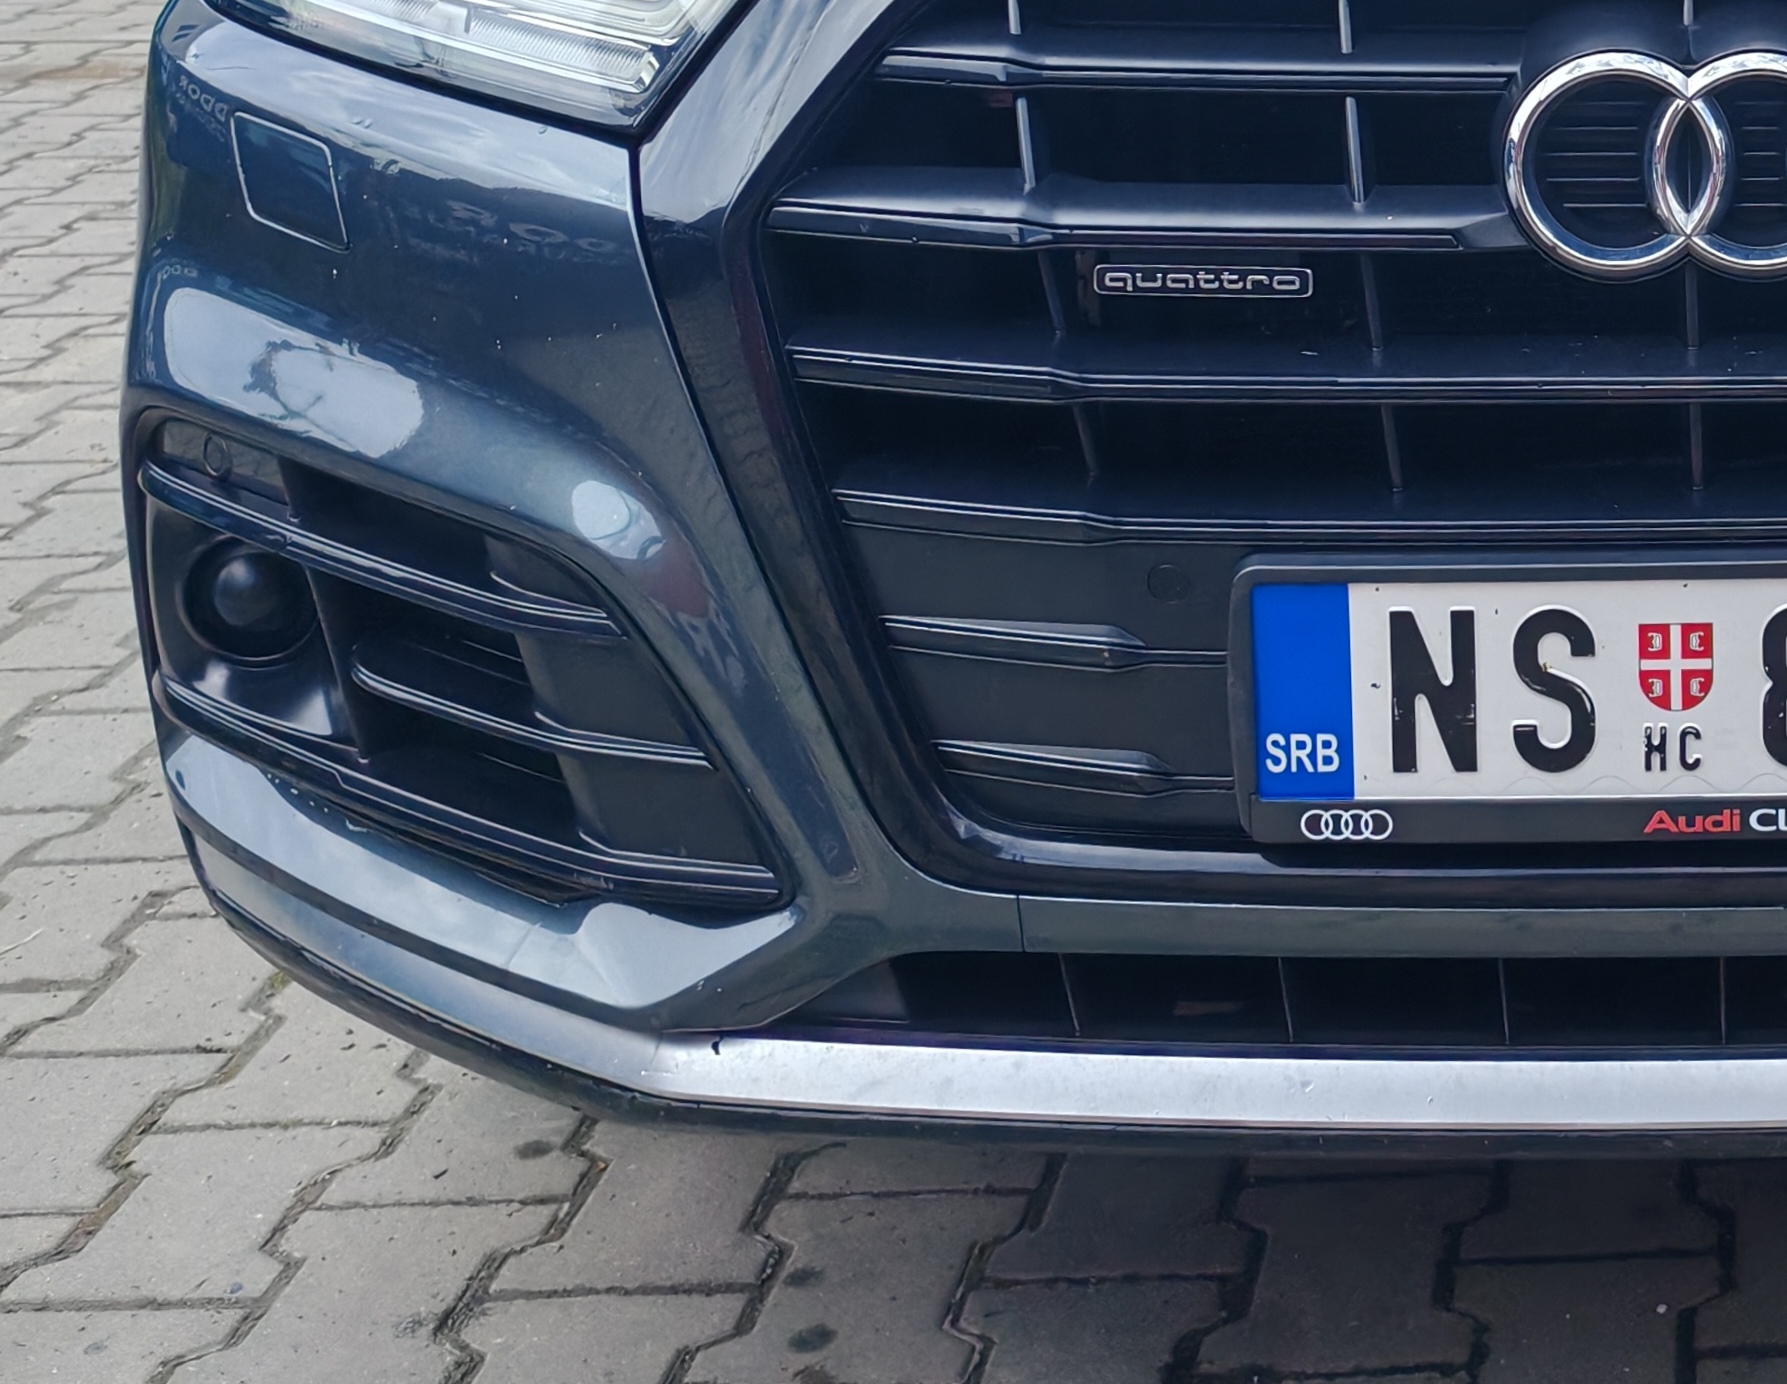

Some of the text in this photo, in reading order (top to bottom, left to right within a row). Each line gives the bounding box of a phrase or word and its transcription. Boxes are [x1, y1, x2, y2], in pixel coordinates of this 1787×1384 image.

[1104, 271, 1301, 292] quattro
[1388, 606, 1597, 774] NS
[1264, 732, 1341, 774] SRB
[1643, 809, 1740, 834] Audi
